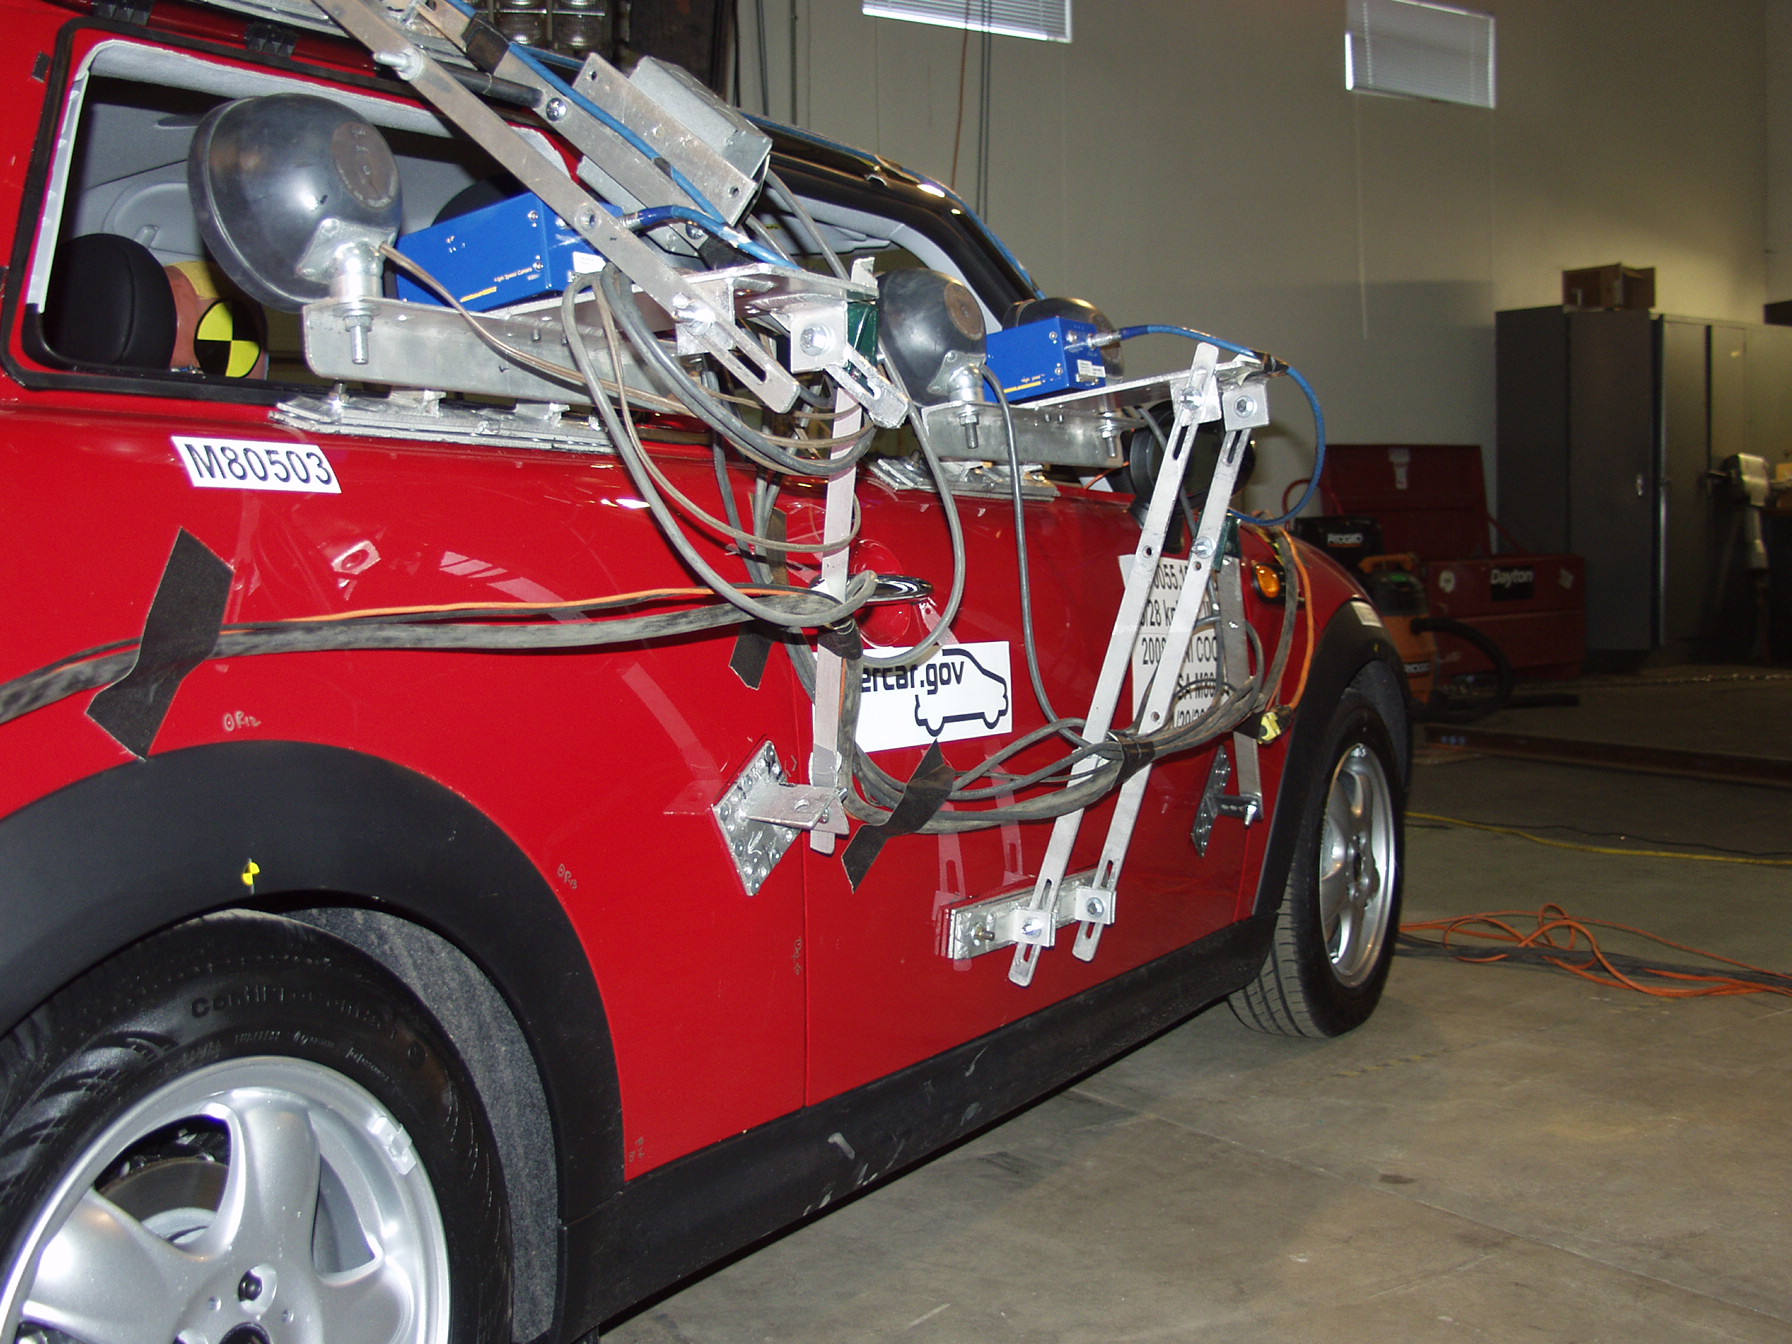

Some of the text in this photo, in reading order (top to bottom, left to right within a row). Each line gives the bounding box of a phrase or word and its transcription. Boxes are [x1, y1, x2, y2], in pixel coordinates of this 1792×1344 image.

[184, 443, 332, 485] M80503
[1490, 569, 1534, 589] Dayton
[861, 661, 965, 695] ercar.gov
